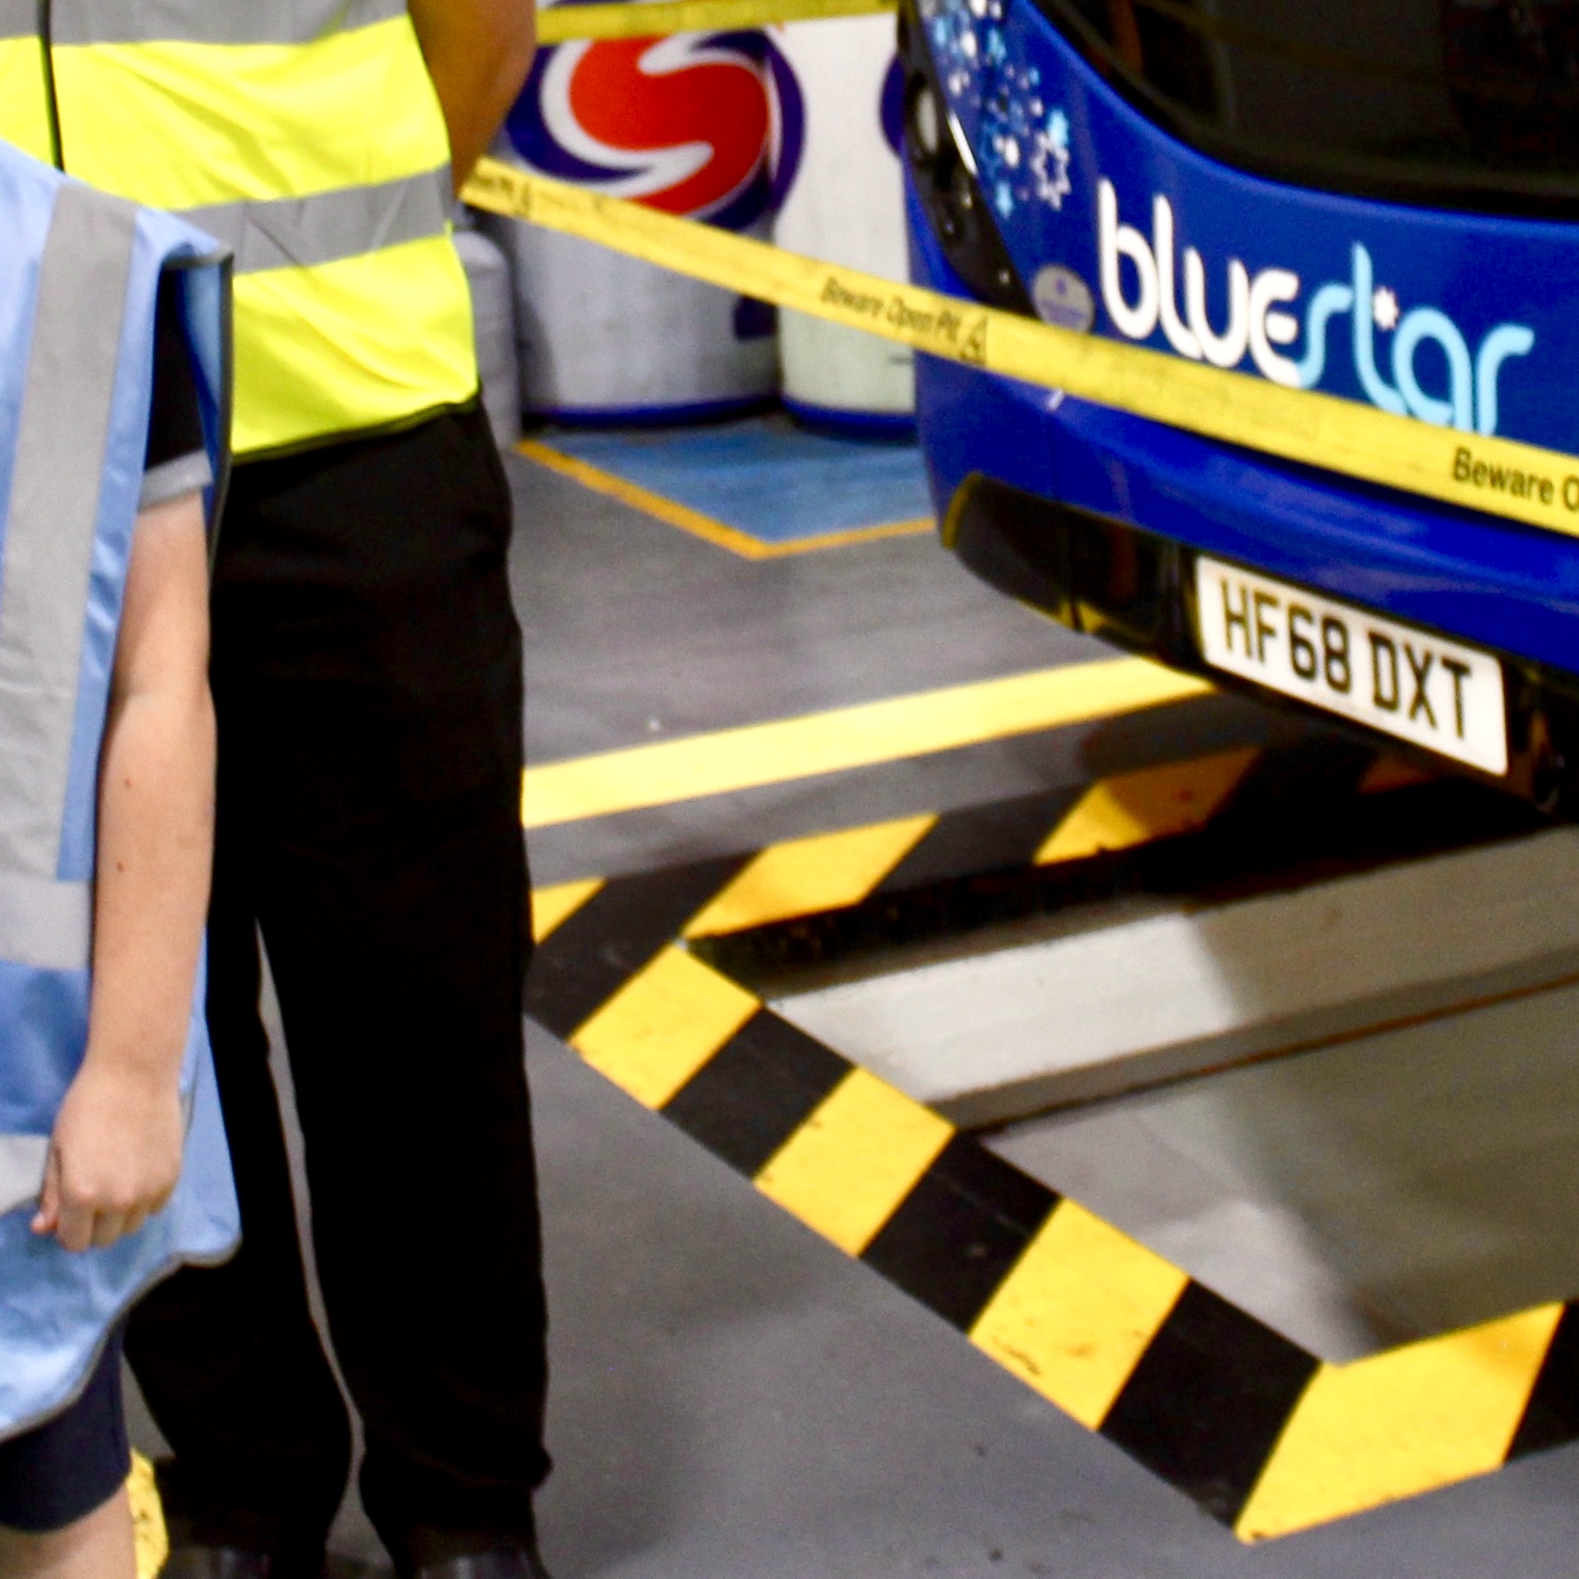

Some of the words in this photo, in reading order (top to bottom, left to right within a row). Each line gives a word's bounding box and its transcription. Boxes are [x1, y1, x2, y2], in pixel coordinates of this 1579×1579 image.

[820, 276, 884, 319] Beware
[887, 294, 934, 333] Open
[935, 309, 962, 343] Pit
[1096, 176, 1534, 438] bluestar
[1452, 446, 1554, 505] Beware
[1221, 574, 1352, 695] HF68
[1366, 628, 1472, 740] DXT
